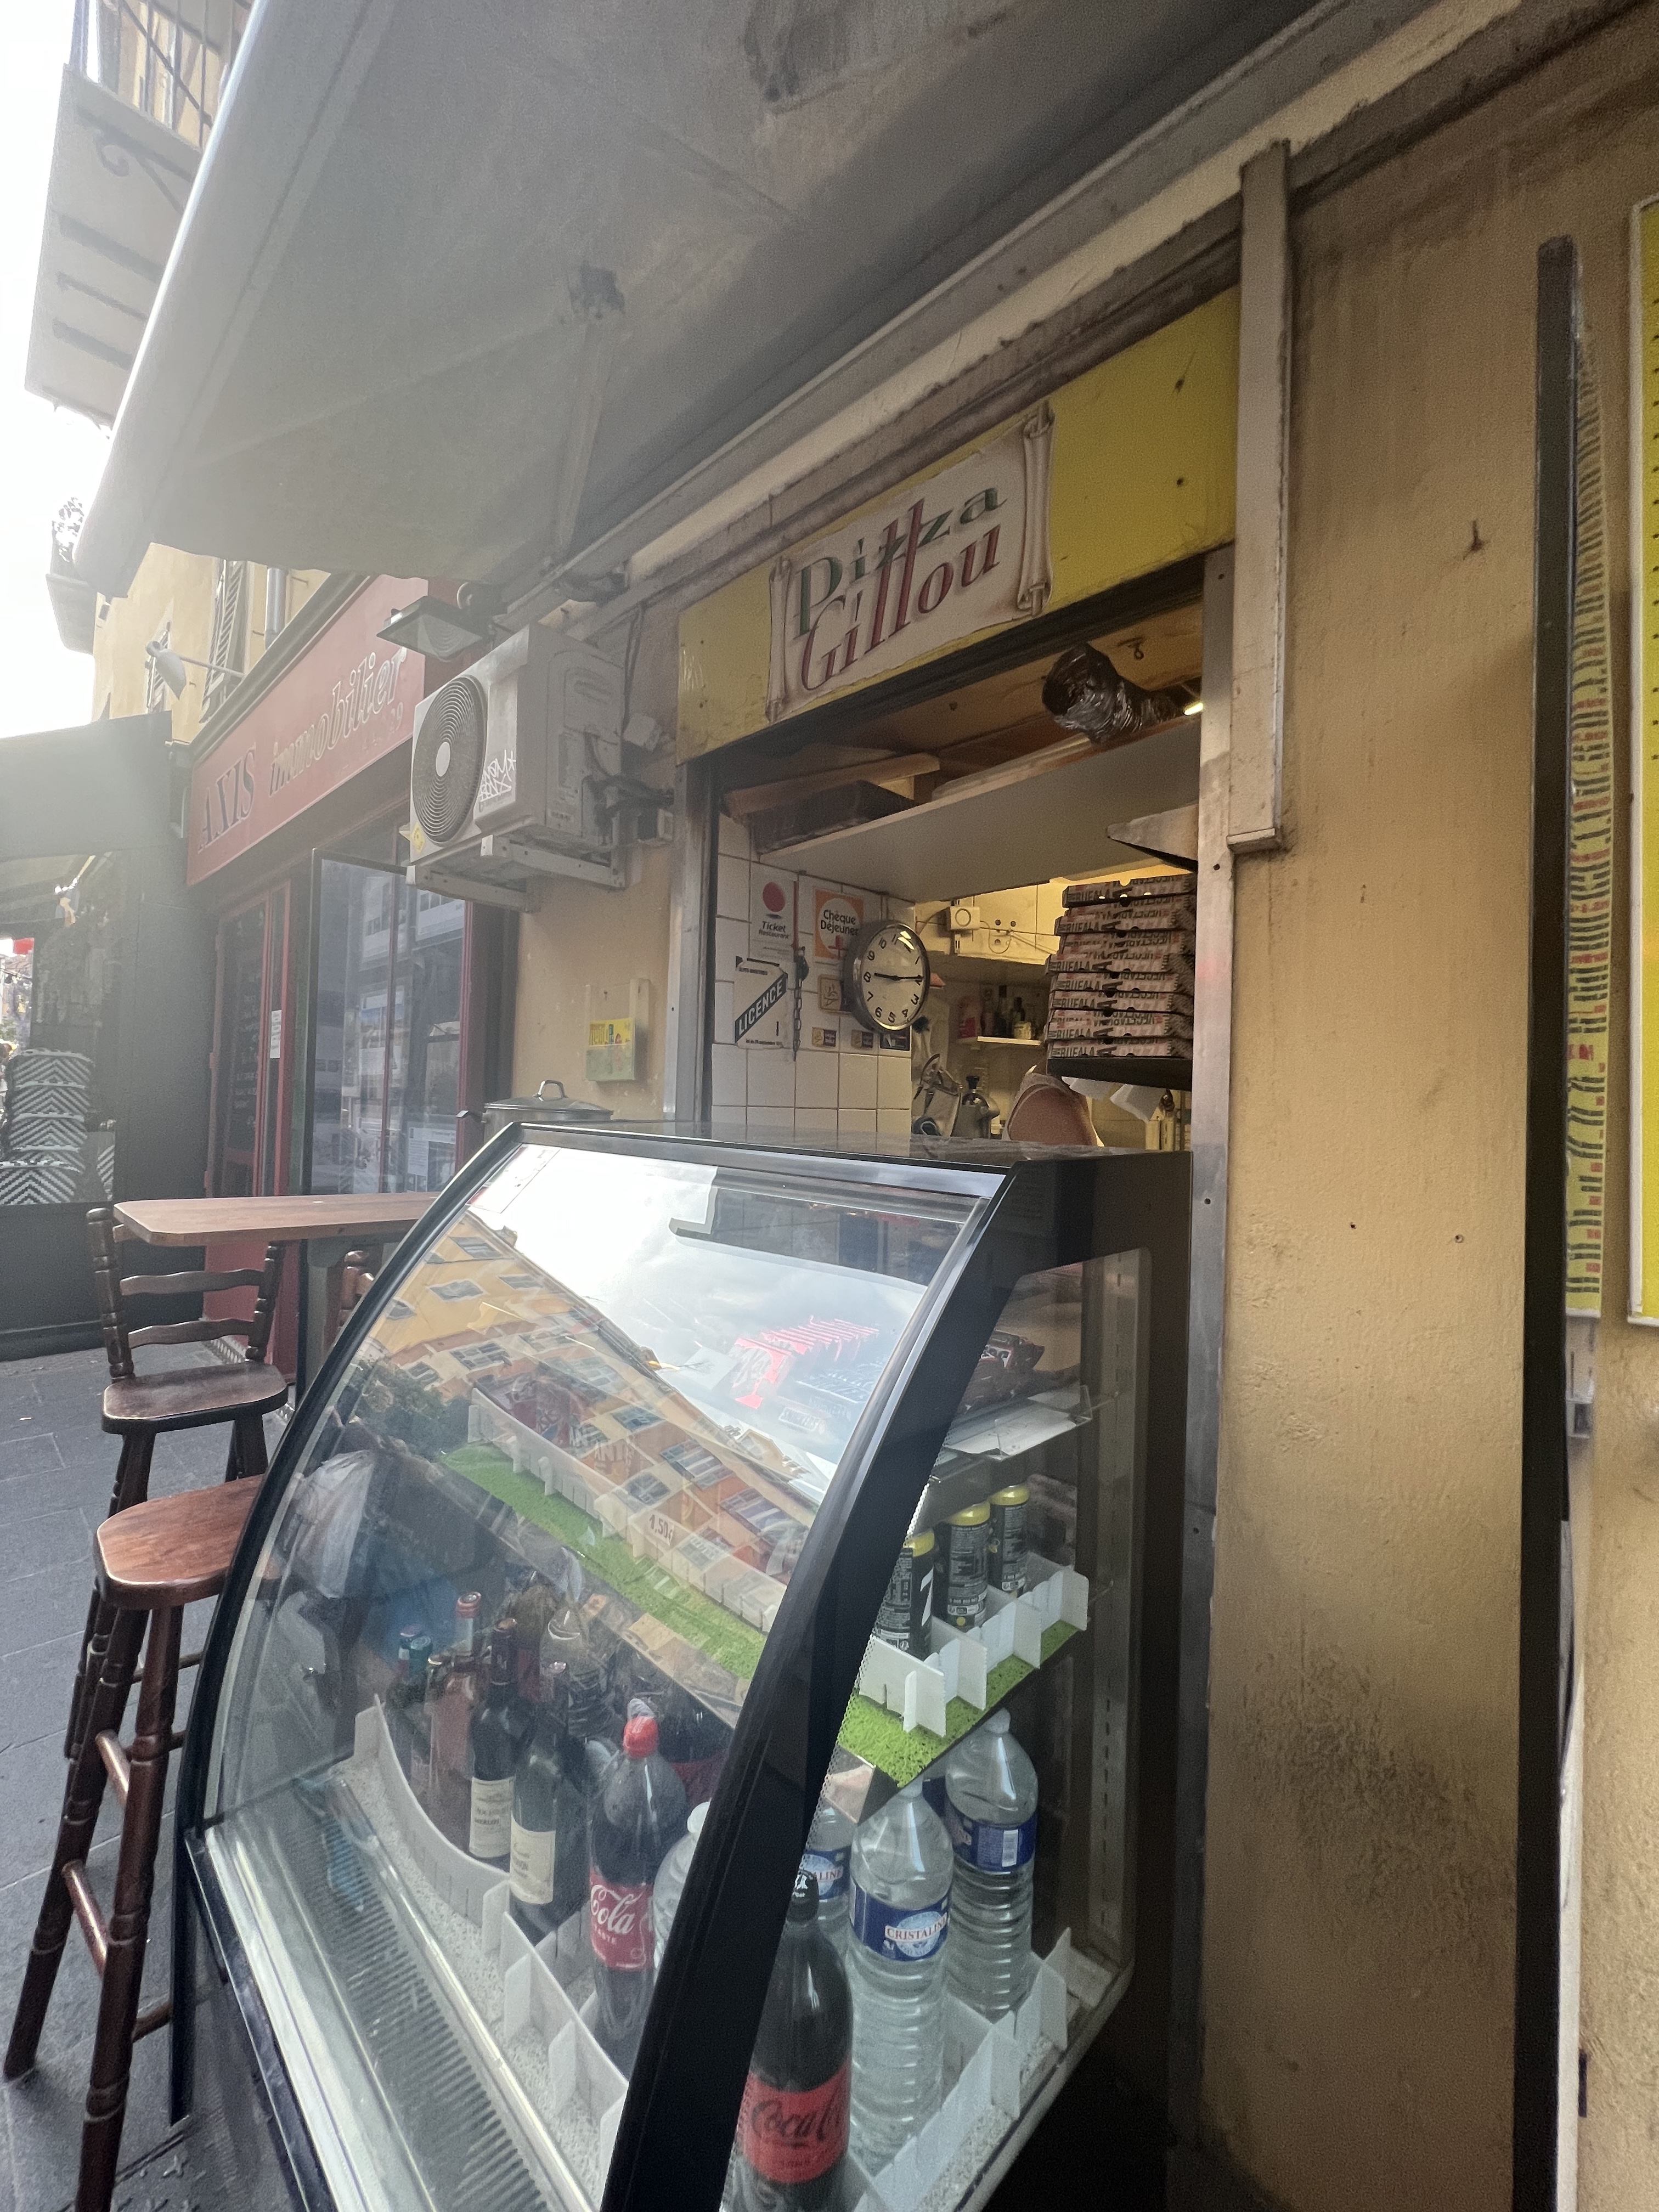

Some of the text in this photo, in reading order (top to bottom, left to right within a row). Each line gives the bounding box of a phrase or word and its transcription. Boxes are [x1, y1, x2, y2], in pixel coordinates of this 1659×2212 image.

[793, 485, 1008, 640] Pizza
[800, 498, 1002, 692] Gillou
[269, 647, 407, 797] immobilier
[762, 921, 786, 933] Ticket
[821, 919, 859, 936] Déjeuner
[823, 909, 856, 926] Chèque
[738, 984, 785, 1037] LICENCE
[591, 1884, 644, 1934] Cola
